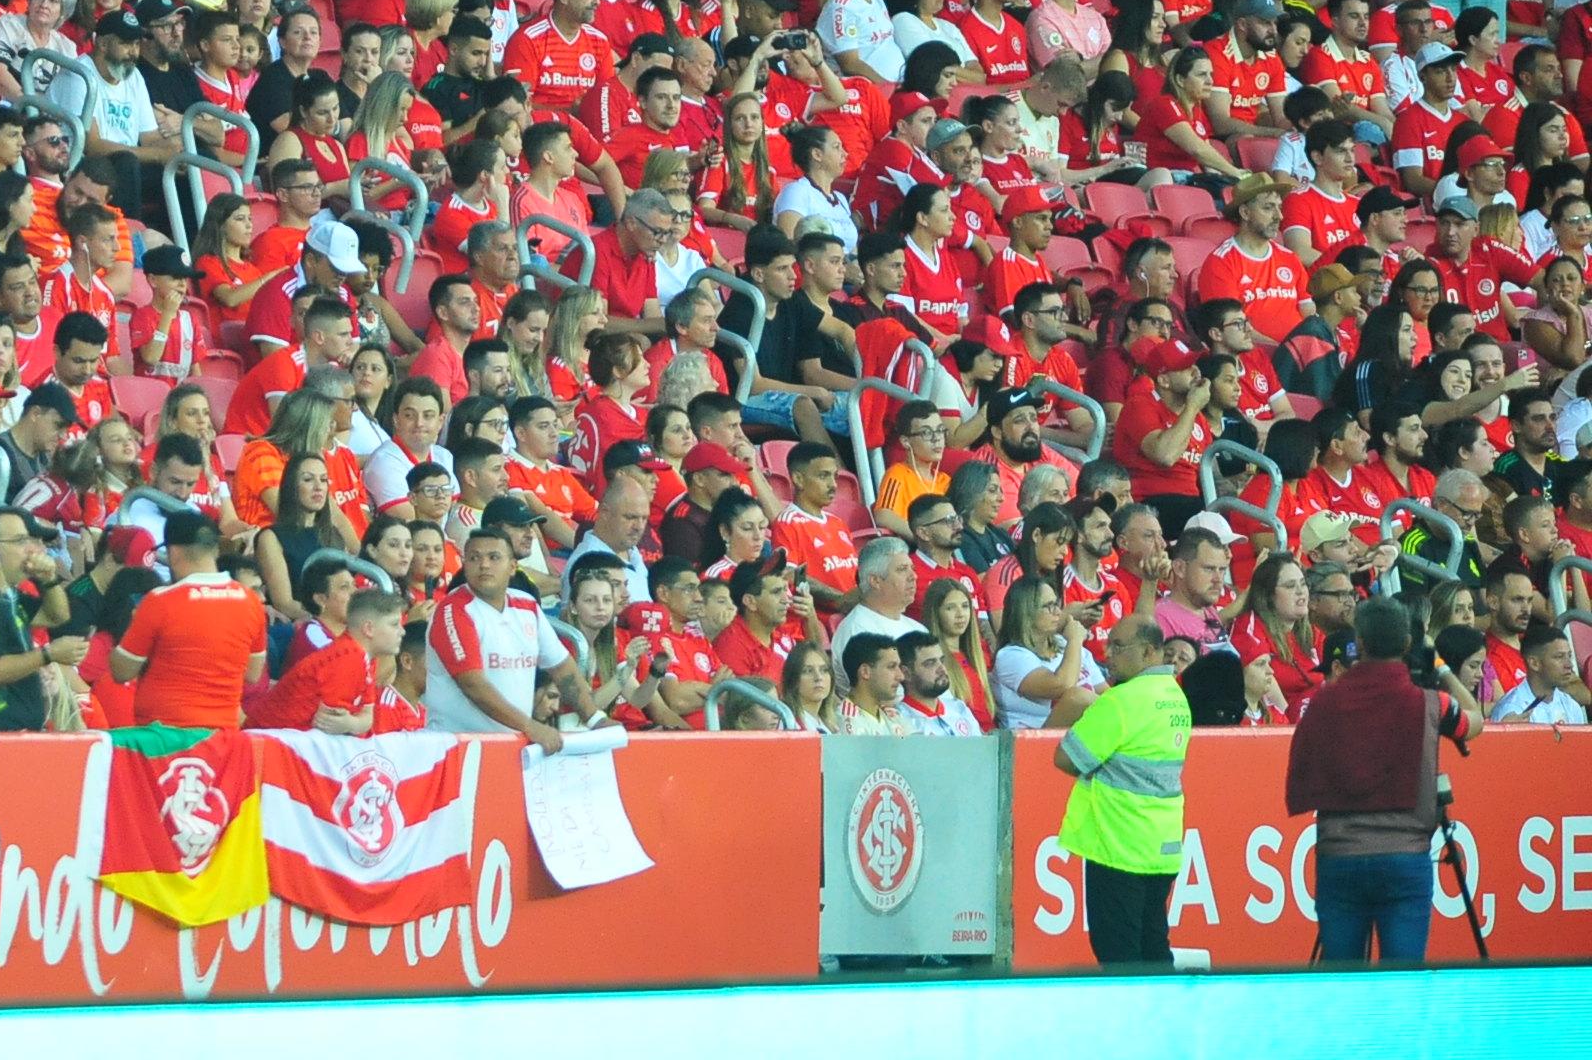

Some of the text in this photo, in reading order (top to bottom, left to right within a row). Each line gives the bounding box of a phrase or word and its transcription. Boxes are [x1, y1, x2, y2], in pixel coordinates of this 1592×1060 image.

[1033, 828, 1220, 936] SA
[1244, 808, 1496, 938] SÓO,
[951, 930, 988, 943] BEIRA-RIO
